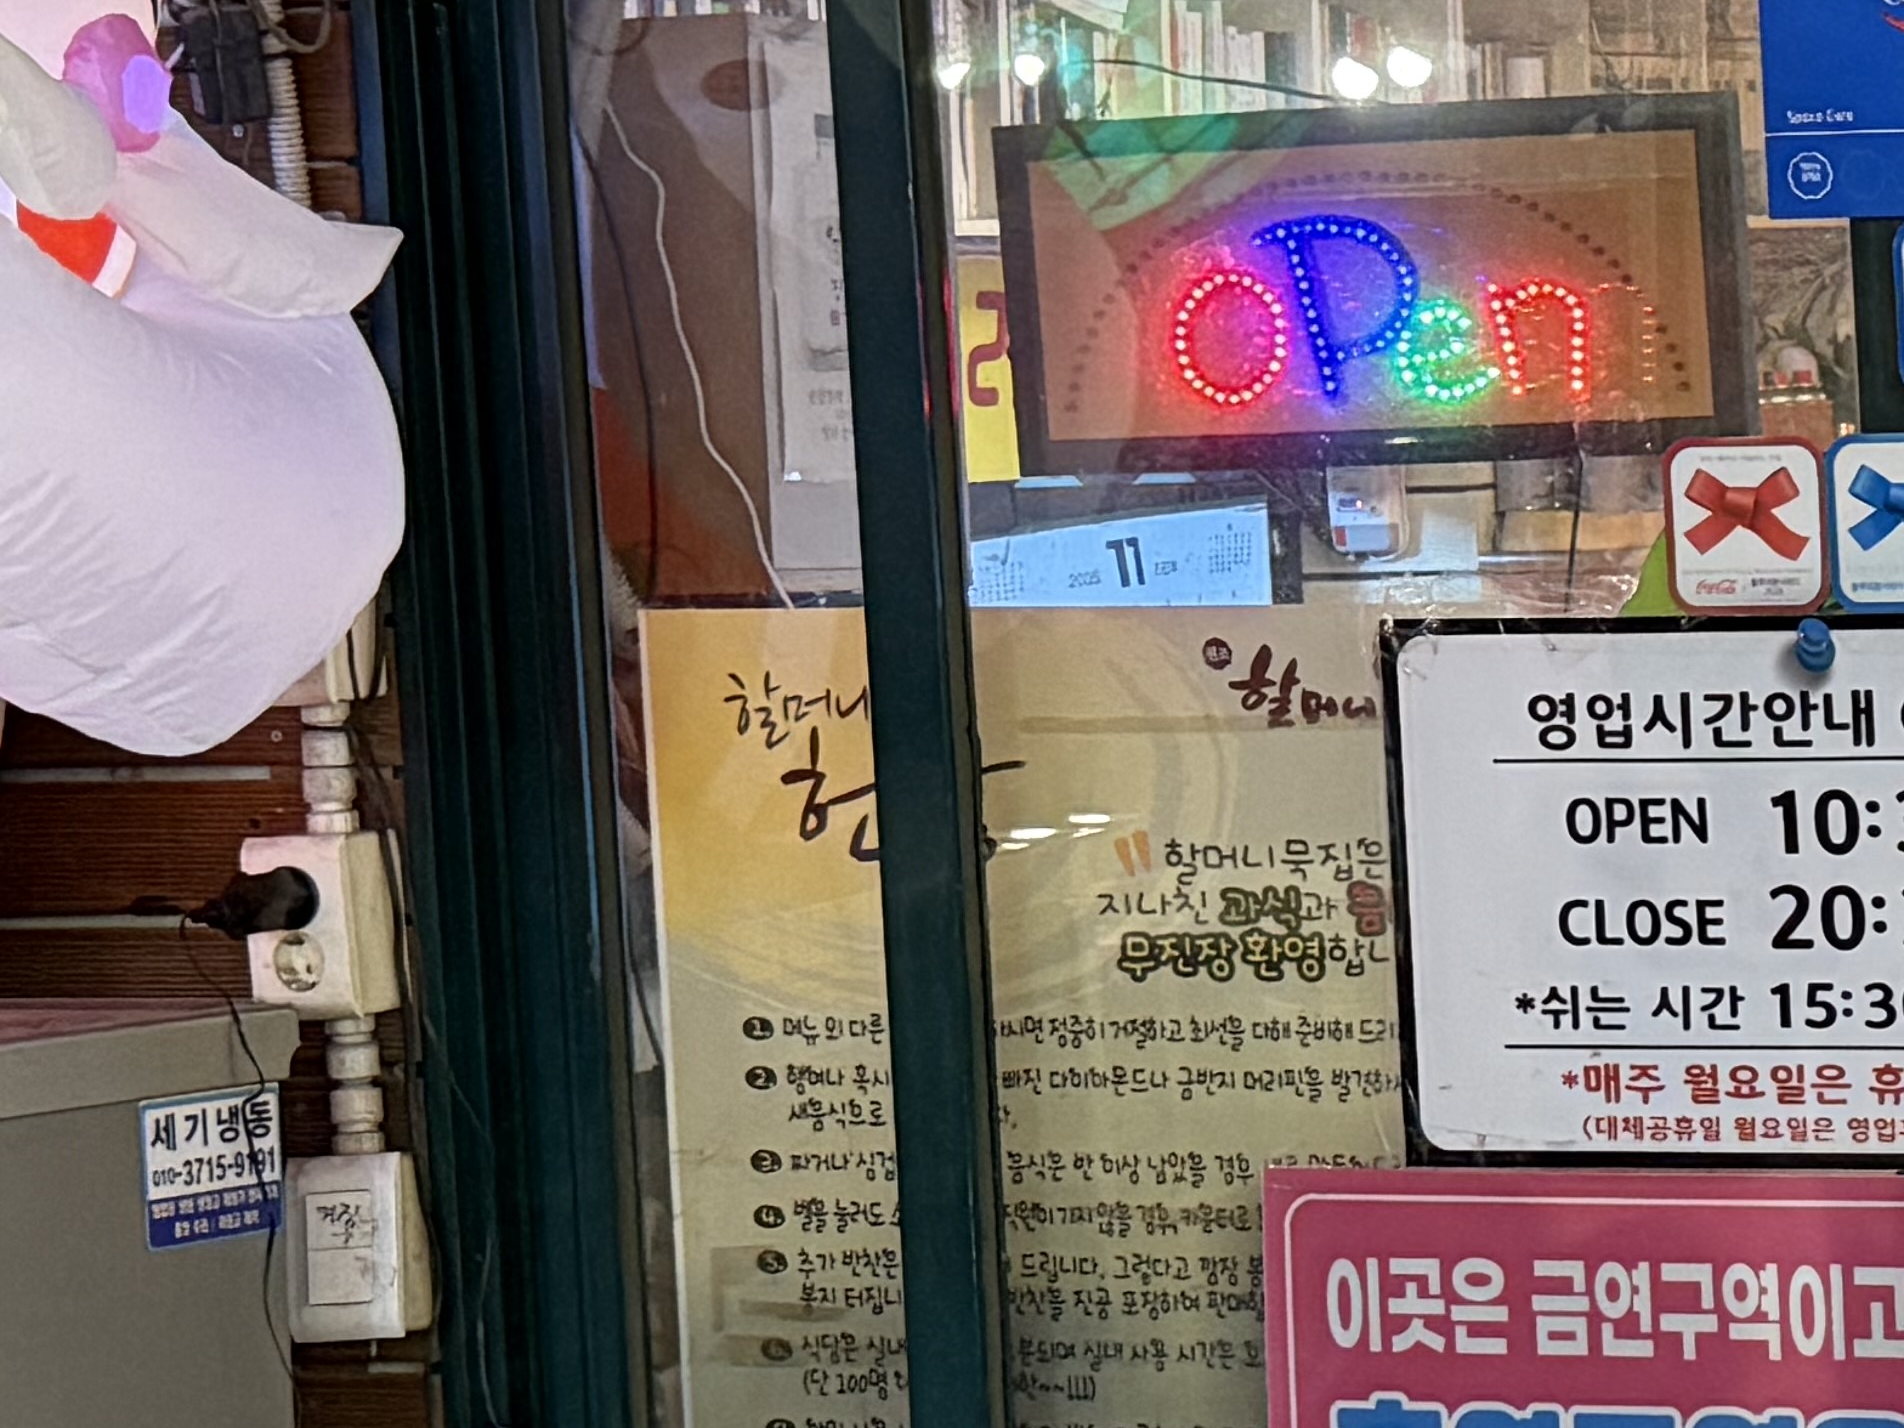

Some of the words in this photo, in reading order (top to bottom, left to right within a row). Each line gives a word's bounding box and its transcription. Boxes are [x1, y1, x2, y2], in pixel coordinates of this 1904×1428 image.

[1527, 688, 1876, 751] 영업시간안내
[1564, 797, 1709, 845] OPEN
[1164, 837, 1387, 885] 할머니묵집은
[1097, 885, 1207, 926] 지나친
[1557, 897, 1727, 948] CLOSE
[1117, 930, 1238, 983] 무진장
[782, 1014, 820, 1046] 메뉴
[849, 1013, 885, 1044] 다른
[1650, 984, 1746, 1032] 시간
[1682, 1063, 1852, 1106] 월요일은
[1581, 1116, 1723, 1145] (대체공휴일
[1733, 1117, 1835, 1145] 월요일은
[798, 1247, 835, 1280] 추가
[841, 1247, 900, 1280] 반찬은
[1325, 1255, 1510, 1357] 이곳은
